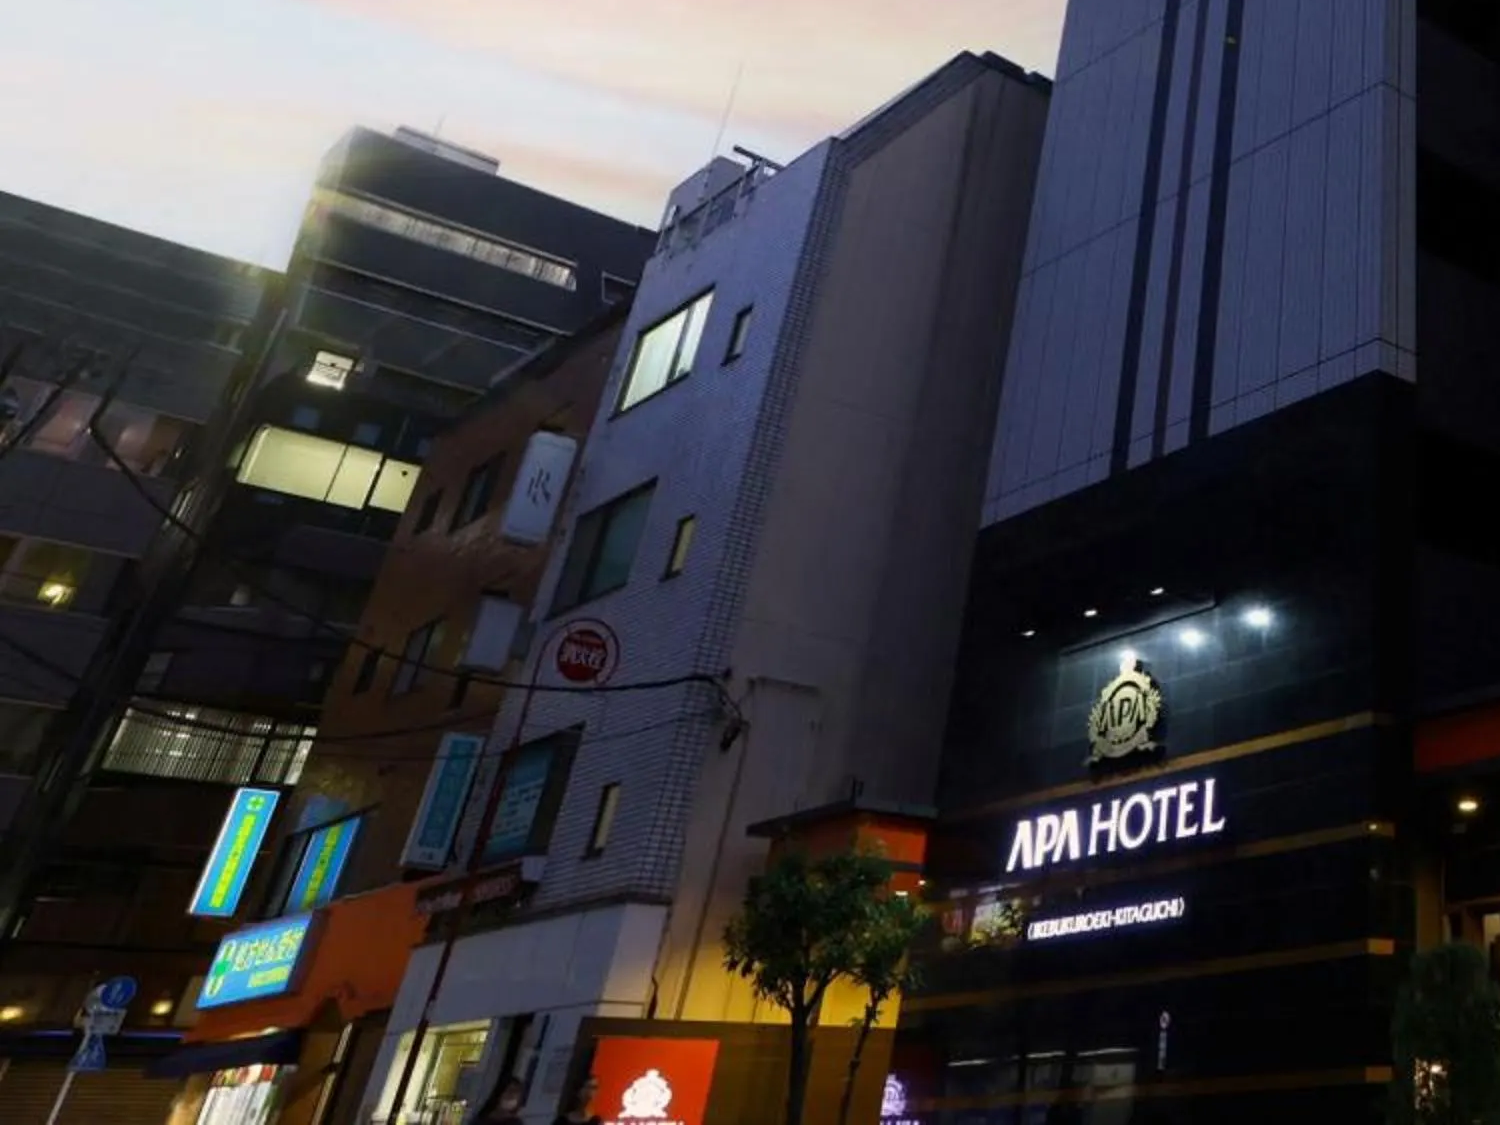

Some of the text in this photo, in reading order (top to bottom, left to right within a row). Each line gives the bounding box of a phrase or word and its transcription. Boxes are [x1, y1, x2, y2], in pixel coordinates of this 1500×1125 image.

[1098, 691, 1148, 736] APA
[1005, 778, 1226, 872] APA HOTEL
